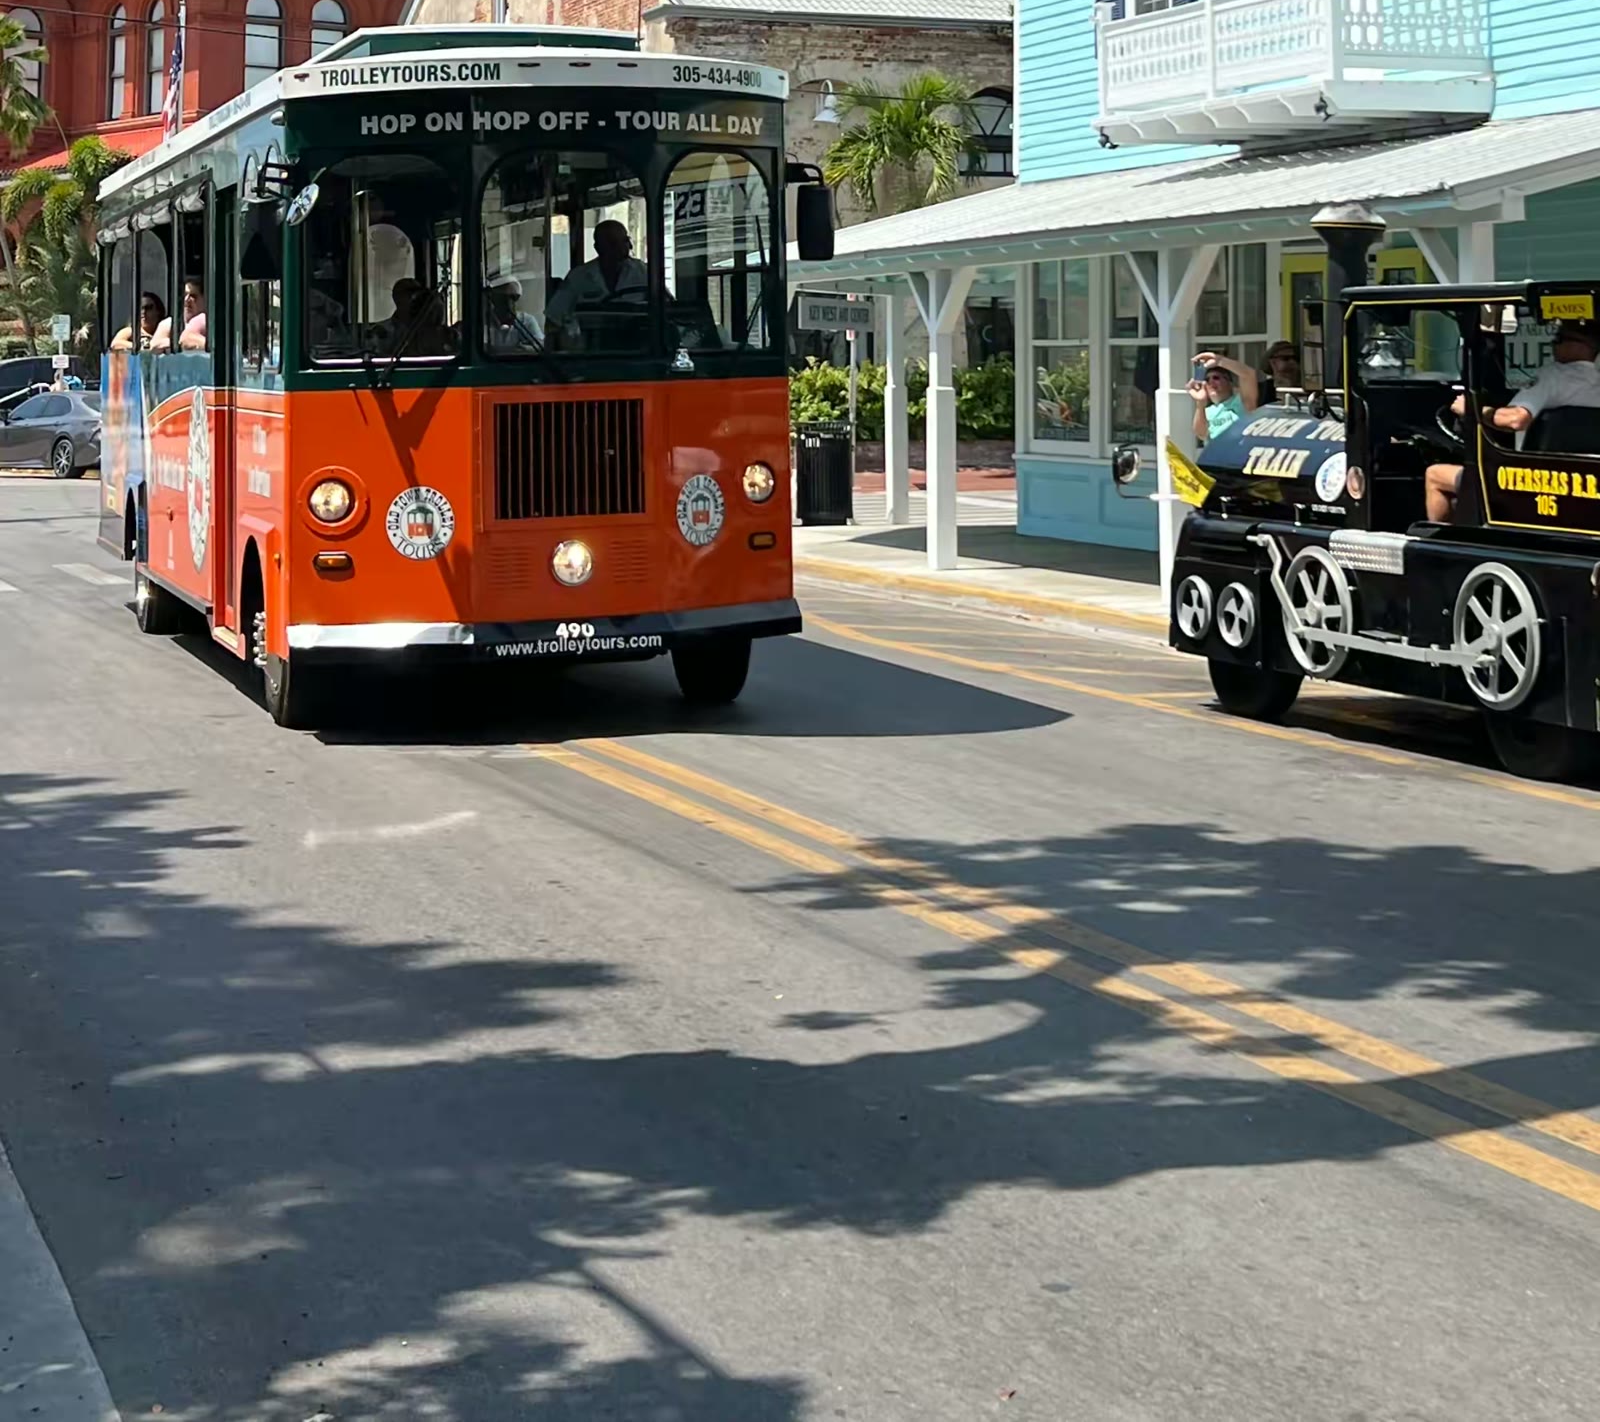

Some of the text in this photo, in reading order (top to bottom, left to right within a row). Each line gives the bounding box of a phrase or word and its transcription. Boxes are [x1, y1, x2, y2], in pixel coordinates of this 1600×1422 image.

[320, 62, 501, 87] TROLLEYTOURS.COM
[672, 65, 762, 88] 305-434-4900
[360, 114, 417, 135] HOP
[424, 112, 463, 132] ON
[472, 110, 530, 131] HOP
[538, 111, 590, 131] OFF
[615, 110, 680, 131] TOUR
[686, 112, 721, 133] ALL
[727, 114, 763, 136] DAY
[1548, 301, 1586, 315] JAMES
[1242, 417, 1312, 439] CONCH
[1242, 446, 1311, 478] TRAIN
[1497, 466, 1569, 496] OVERSEAS
[387, 487, 454, 531] OLD TOWN TROLLEY
[1534, 494, 1558, 516] 105
[396, 535, 446, 560] TOURS
[555, 622, 596, 639] 490
[495, 634, 662, 657] www.trolleytours.com
